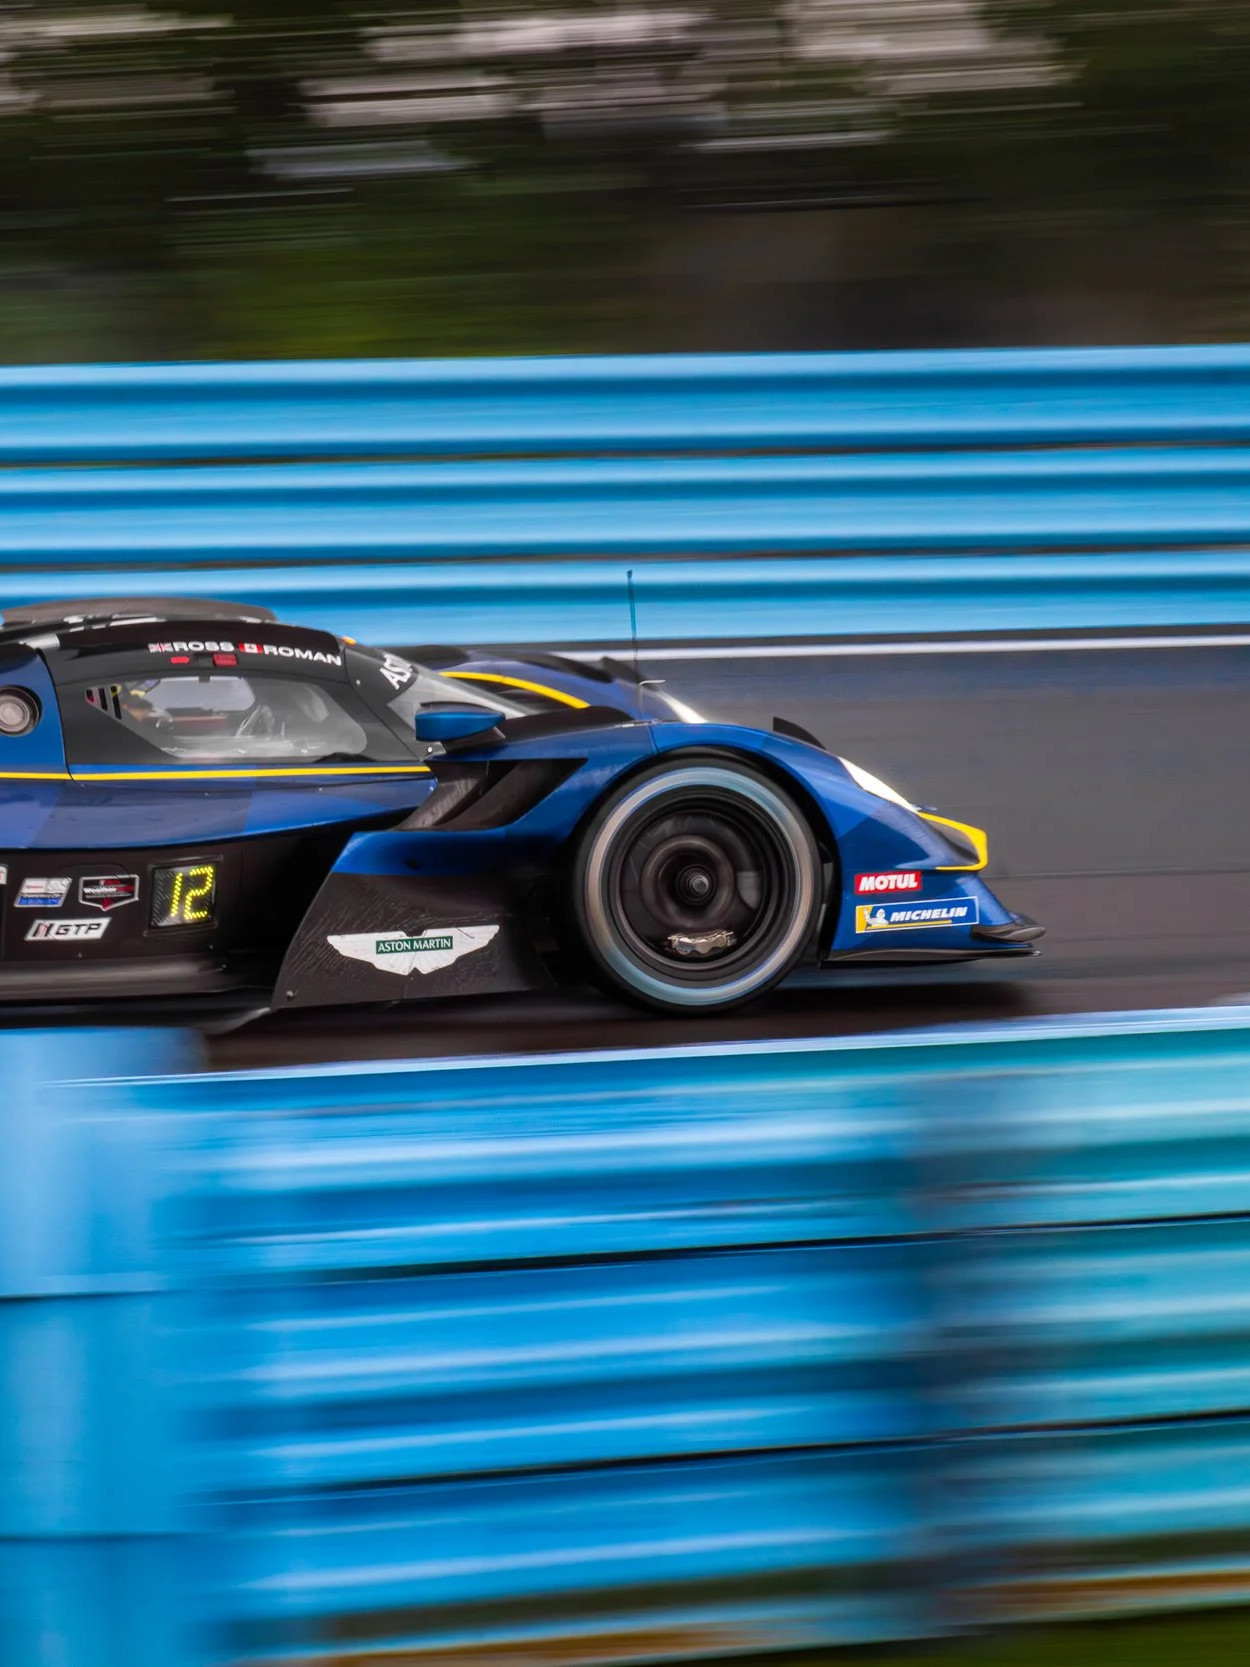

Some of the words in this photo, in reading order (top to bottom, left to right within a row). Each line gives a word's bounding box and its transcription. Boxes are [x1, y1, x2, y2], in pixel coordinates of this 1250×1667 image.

[174, 642, 235, 652] ROSS
[263, 647, 342, 667] ROMAN
[859, 873, 918, 892] MOTUL
[170, 865, 215, 920] 12
[889, 906, 969, 923] MICHELIN
[55, 922, 102, 936] GTP
[377, 941, 411, 953] ASTON
[413, 938, 451, 950] MARTIN
